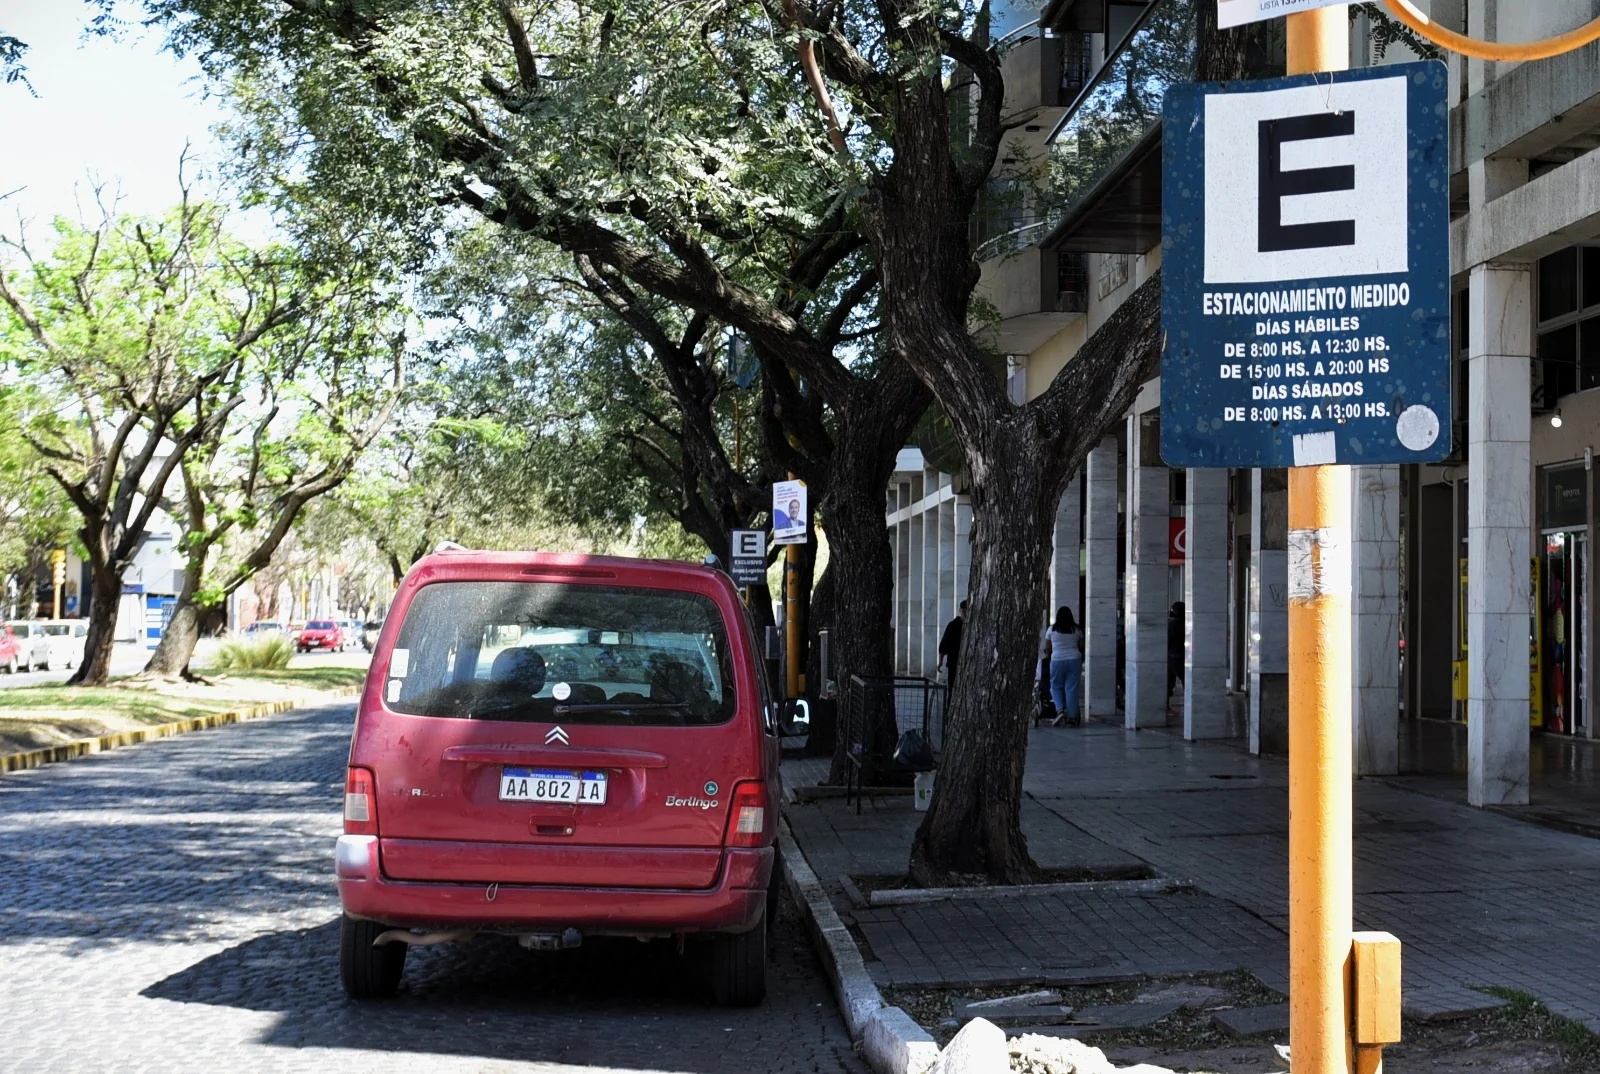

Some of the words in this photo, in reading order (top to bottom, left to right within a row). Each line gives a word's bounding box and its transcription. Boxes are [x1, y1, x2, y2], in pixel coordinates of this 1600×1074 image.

[1260, 0, 1280, 10] LISTA
[1258, 110, 1355, 252] E
[1203, 286, 1346, 315] ESTACIONAMIENTO
[1350, 282, 1410, 309] MEDIDO
[1255, 318, 1290, 335] DÍAS
[1294, 316, 1360, 333] HÁBILES
[1224, 343, 1246, 357] DE
[1250, 342, 1277, 357] 8:00
[1281, 340, 1306, 356] HS.
[1310, 339, 1321, 354] A
[1325, 338, 1360, 354] 12:30
[1364, 336, 1390, 351] HS.
[1220, 364, 1242, 379] DE
[1285, 362, 1310, 377] HS.
[1313, 361, 1325, 376] A
[1329, 359, 1364, 375] 20:00
[1368, 358, 1390, 373] HS
[1252, 382, 1287, 400] DÍAS
[1291, 380, 1364, 399] SÁBADOS
[1224, 407, 1246, 421] DE
[1250, 407, 1278, 422] 8:00
[1282, 405, 1307, 420] HS.
[1311, 405, 1322, 419] A
[1326, 403, 1361, 419] 13:00
[1364, 402, 1390, 417] HS.
[741, 534, 757, 553] E
[506, 779, 528, 796] AA
[536, 780, 571, 798] 802
[665, 795, 719, 810] Berlingo
